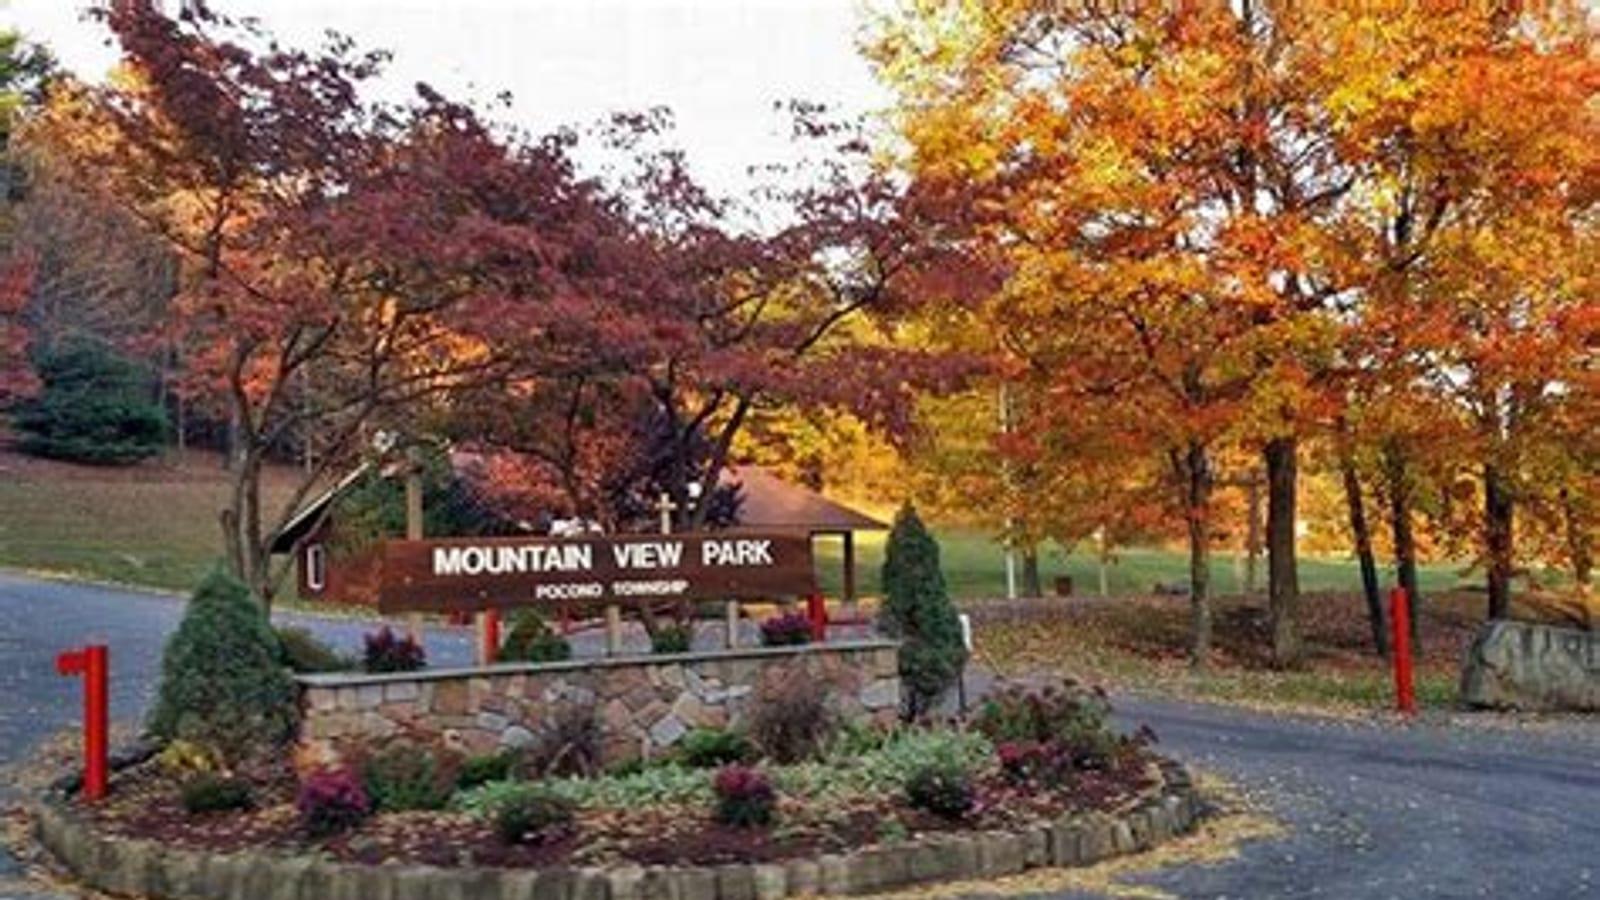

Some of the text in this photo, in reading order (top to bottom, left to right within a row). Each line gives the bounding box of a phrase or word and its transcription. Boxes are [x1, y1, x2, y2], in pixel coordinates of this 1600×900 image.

[433, 539, 773, 575] MOUNTAIN VIEW PARK
[535, 579, 688, 599] POCONO TOWNSHIP
